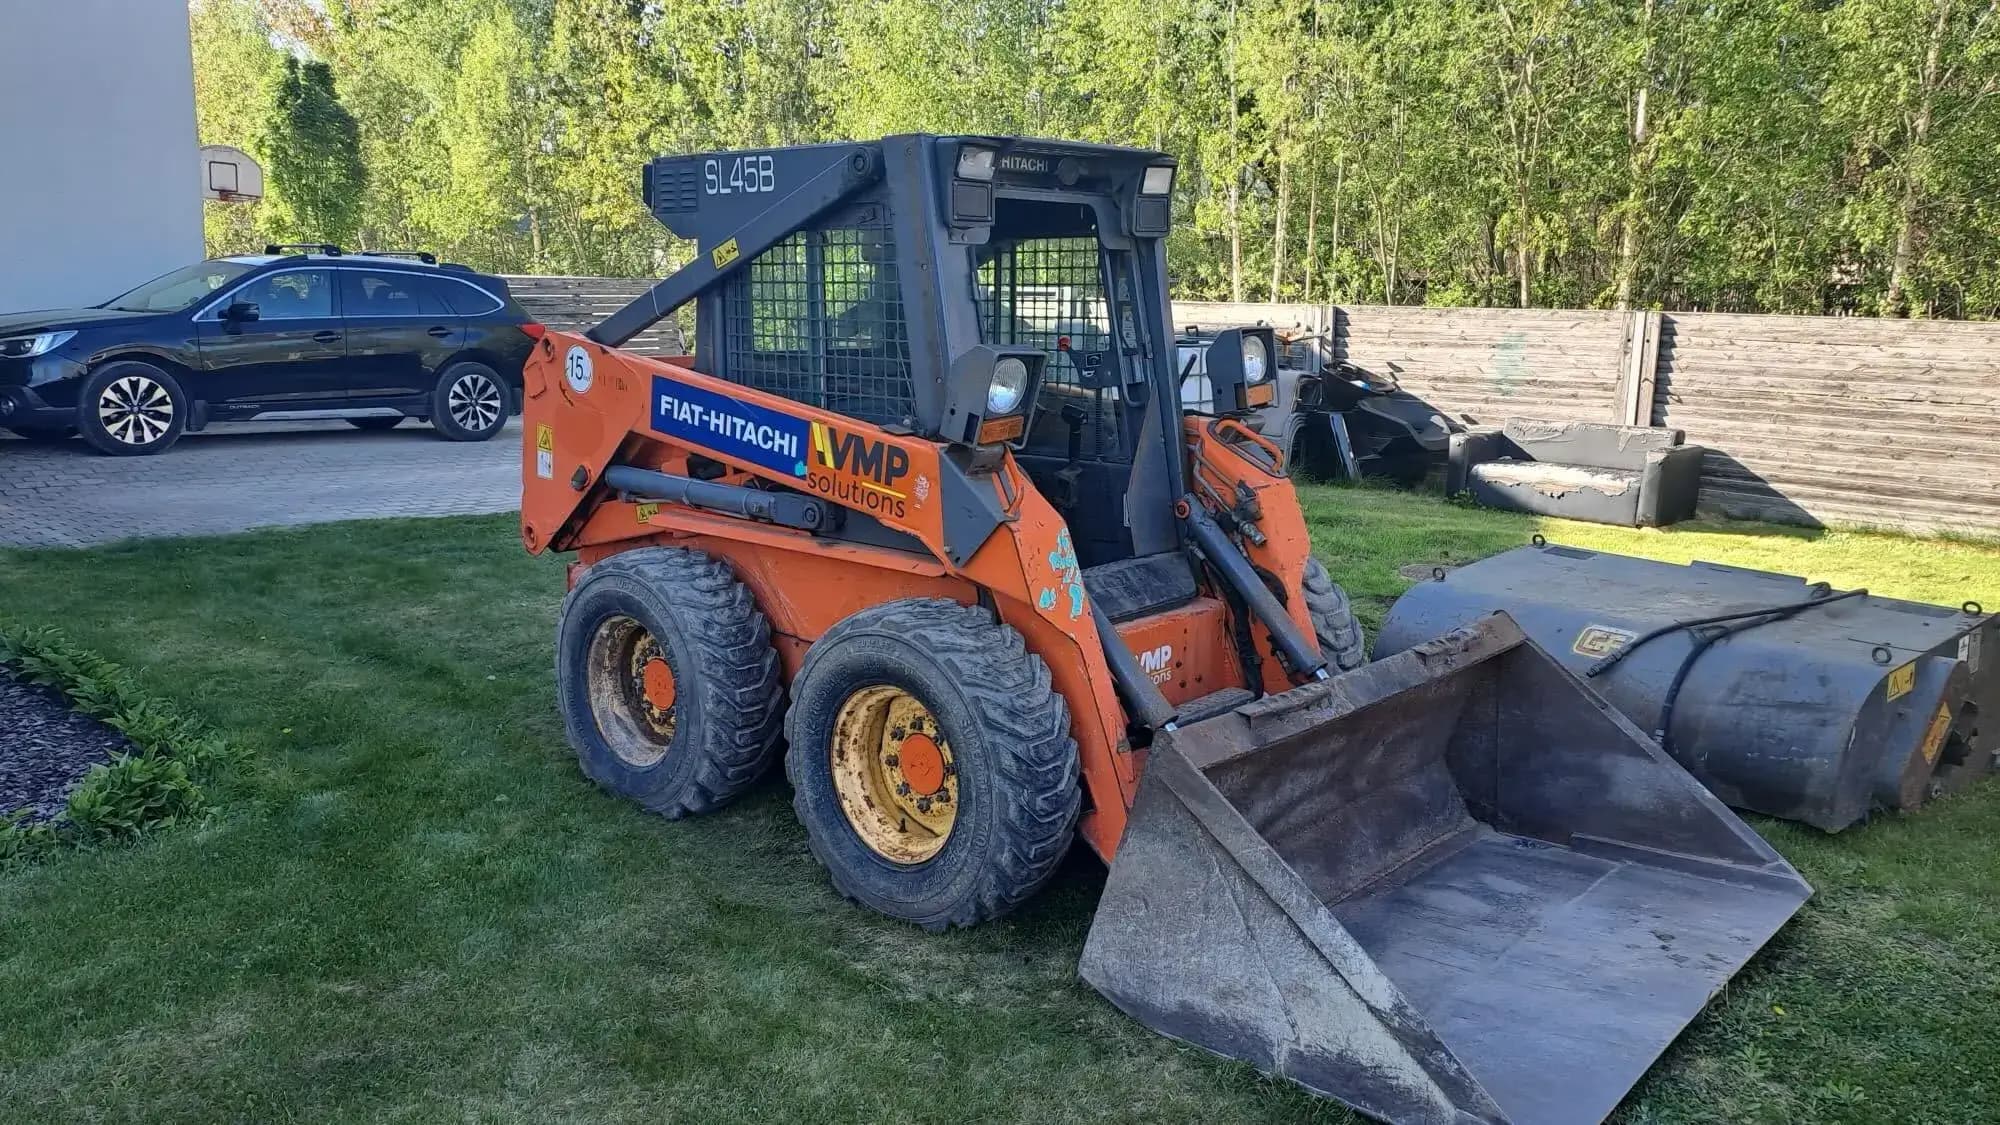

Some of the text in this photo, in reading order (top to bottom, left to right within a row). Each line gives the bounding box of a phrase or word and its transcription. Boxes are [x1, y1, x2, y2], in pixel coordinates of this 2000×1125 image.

[704, 156, 775, 195] SL45B
[569, 354, 584, 381] 15
[660, 395, 798, 458] FIAT-HITACHI
[828, 427, 909, 486] VMP
[807, 471, 905, 518] solutions
